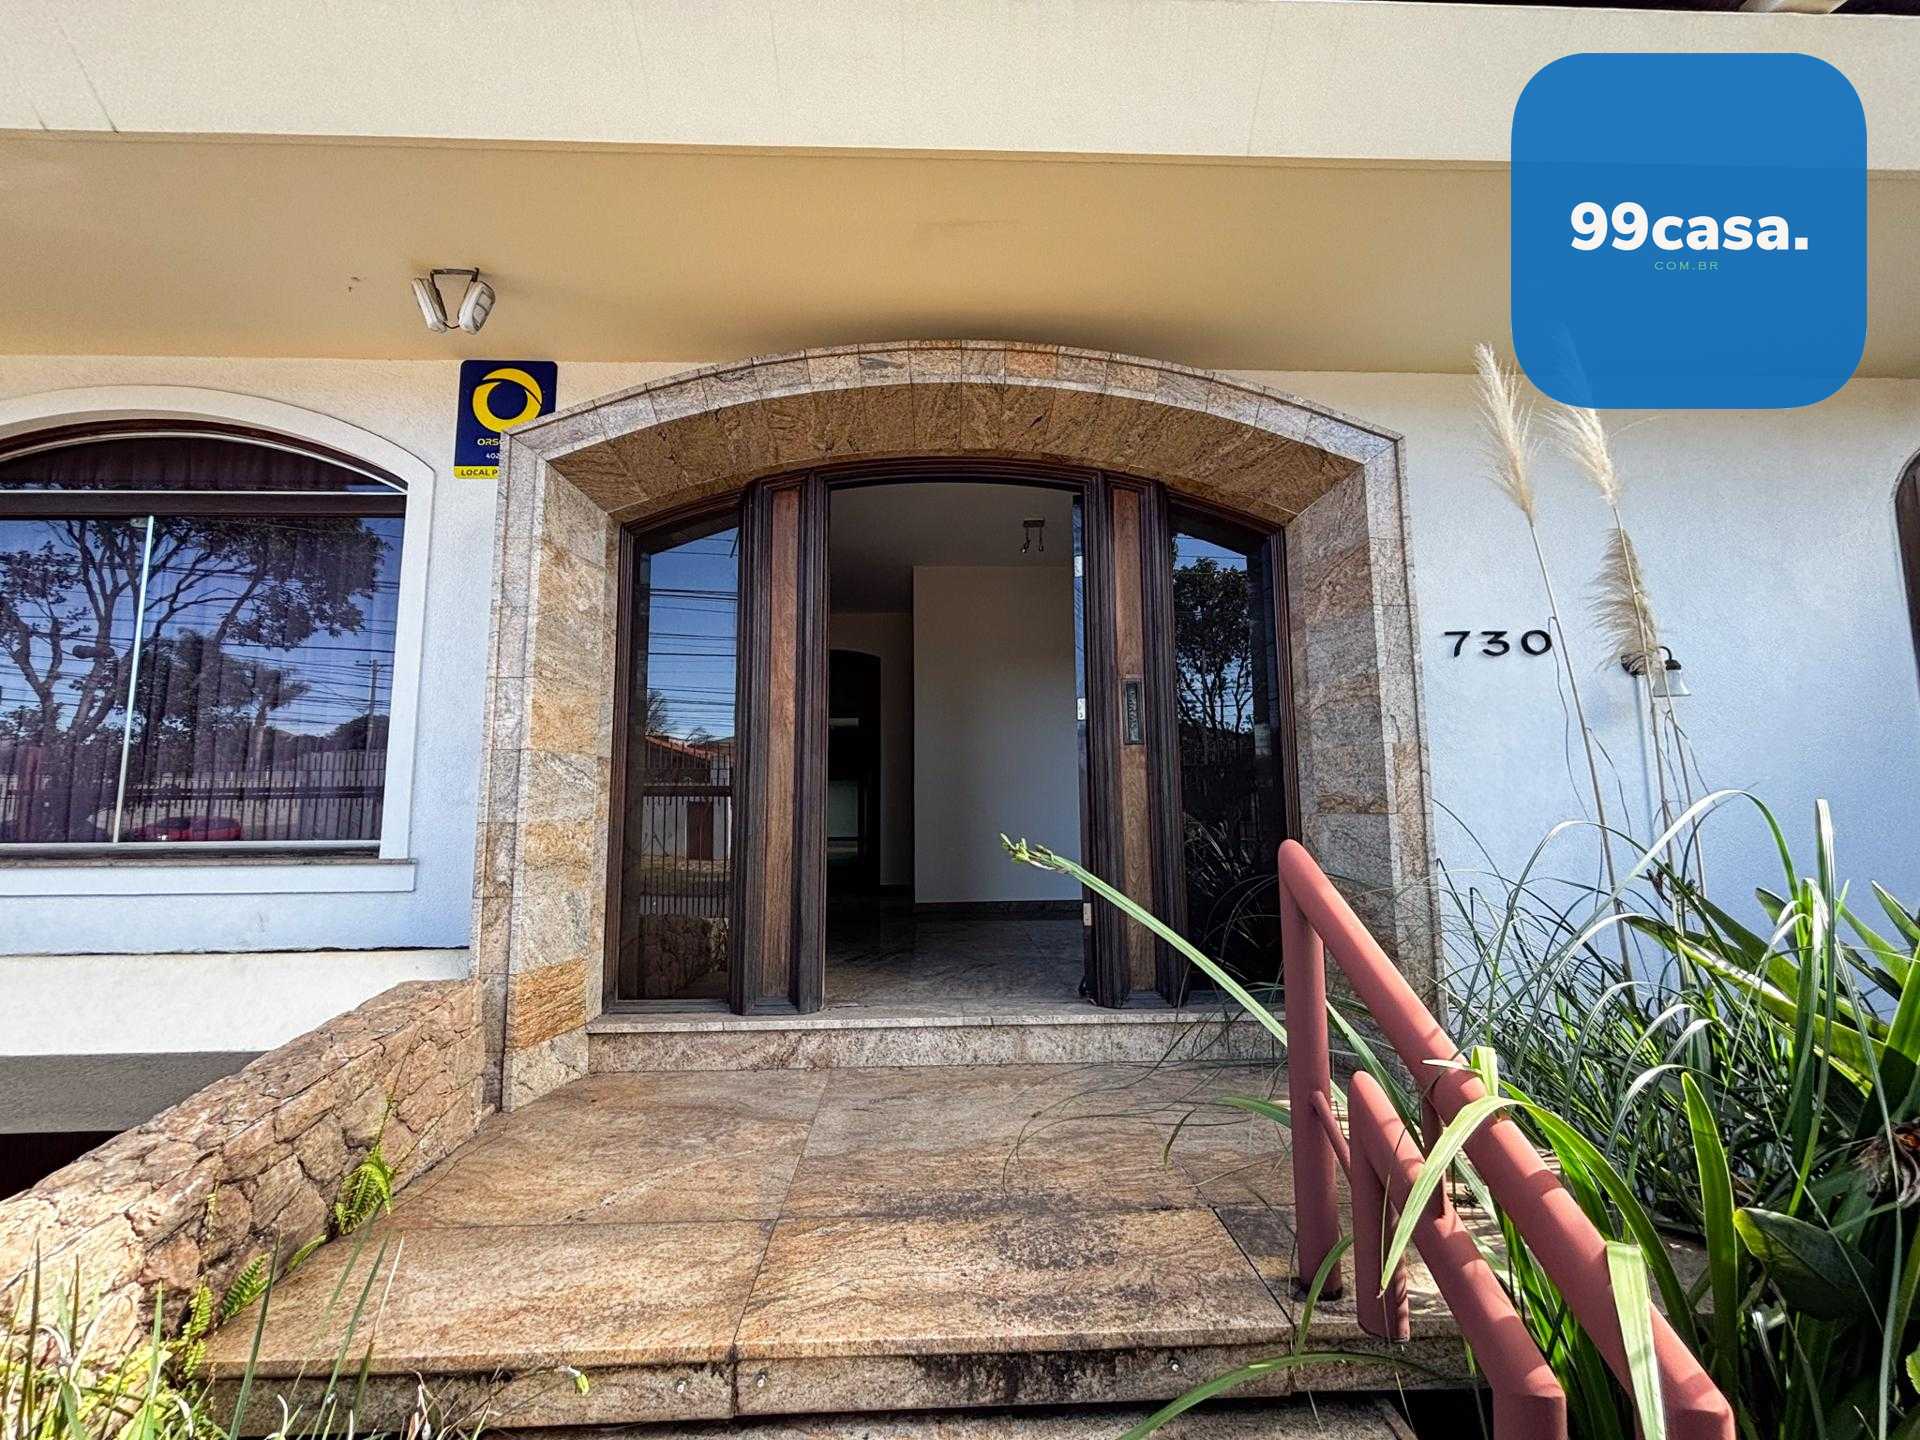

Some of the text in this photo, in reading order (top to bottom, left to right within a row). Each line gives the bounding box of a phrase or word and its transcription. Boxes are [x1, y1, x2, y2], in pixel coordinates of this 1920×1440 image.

[477, 438, 501, 446] ORS
[460, 469, 490, 477] LOCAL
[1443, 630, 1552, 657] 730
